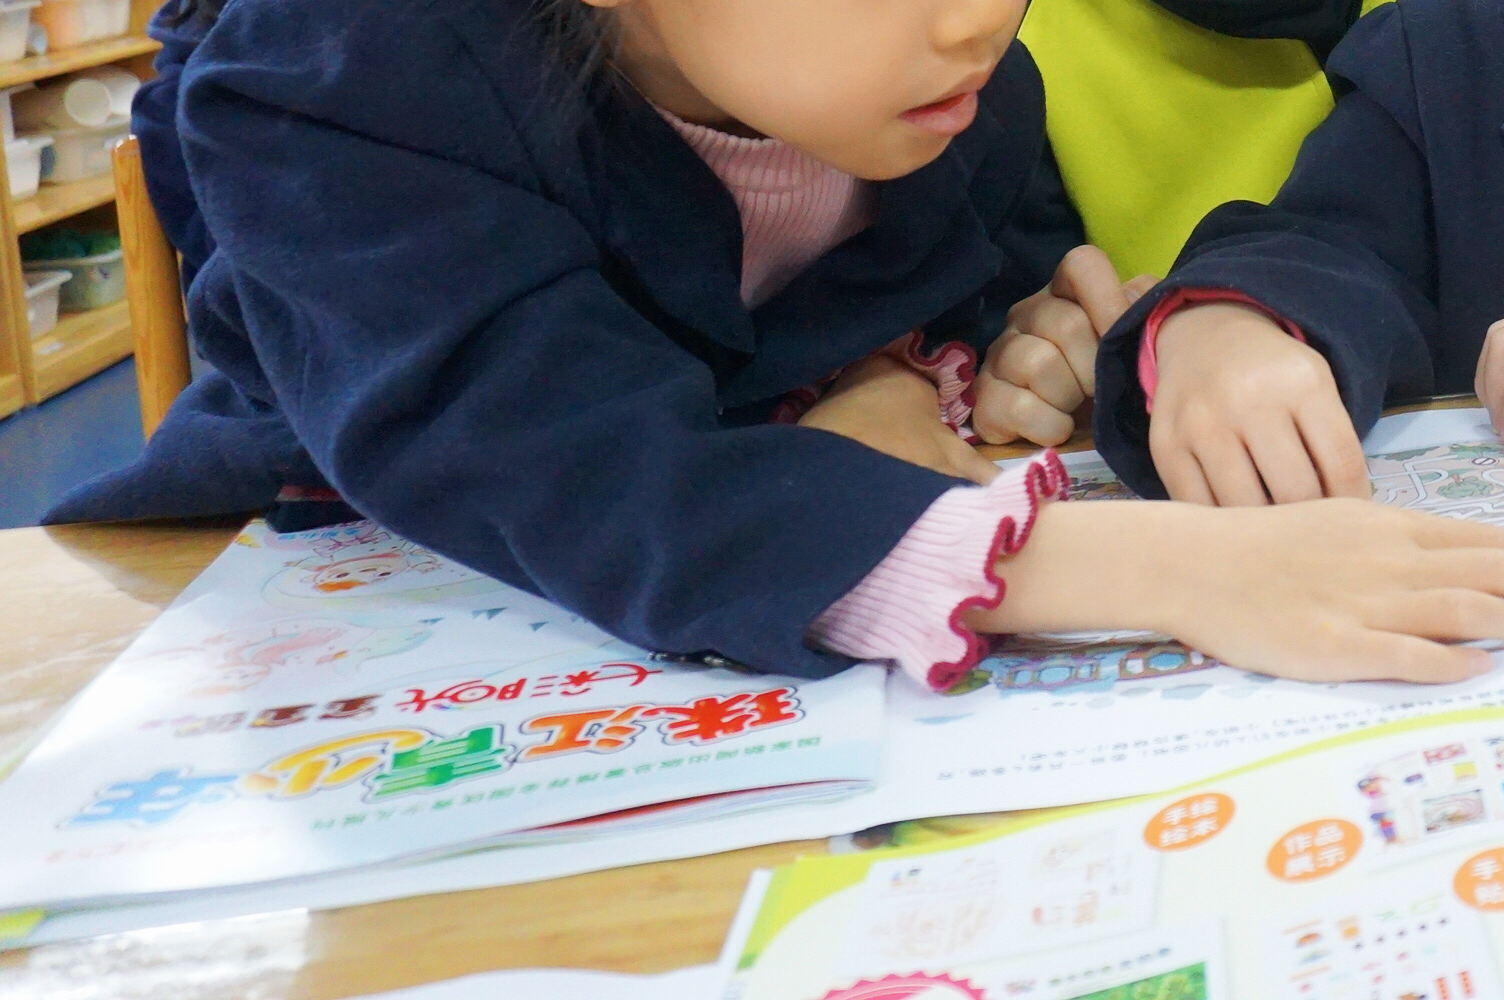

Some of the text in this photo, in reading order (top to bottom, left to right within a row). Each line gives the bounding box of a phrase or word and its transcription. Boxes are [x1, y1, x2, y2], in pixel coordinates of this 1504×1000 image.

[57, 685, 806, 829] 珠江青少年
